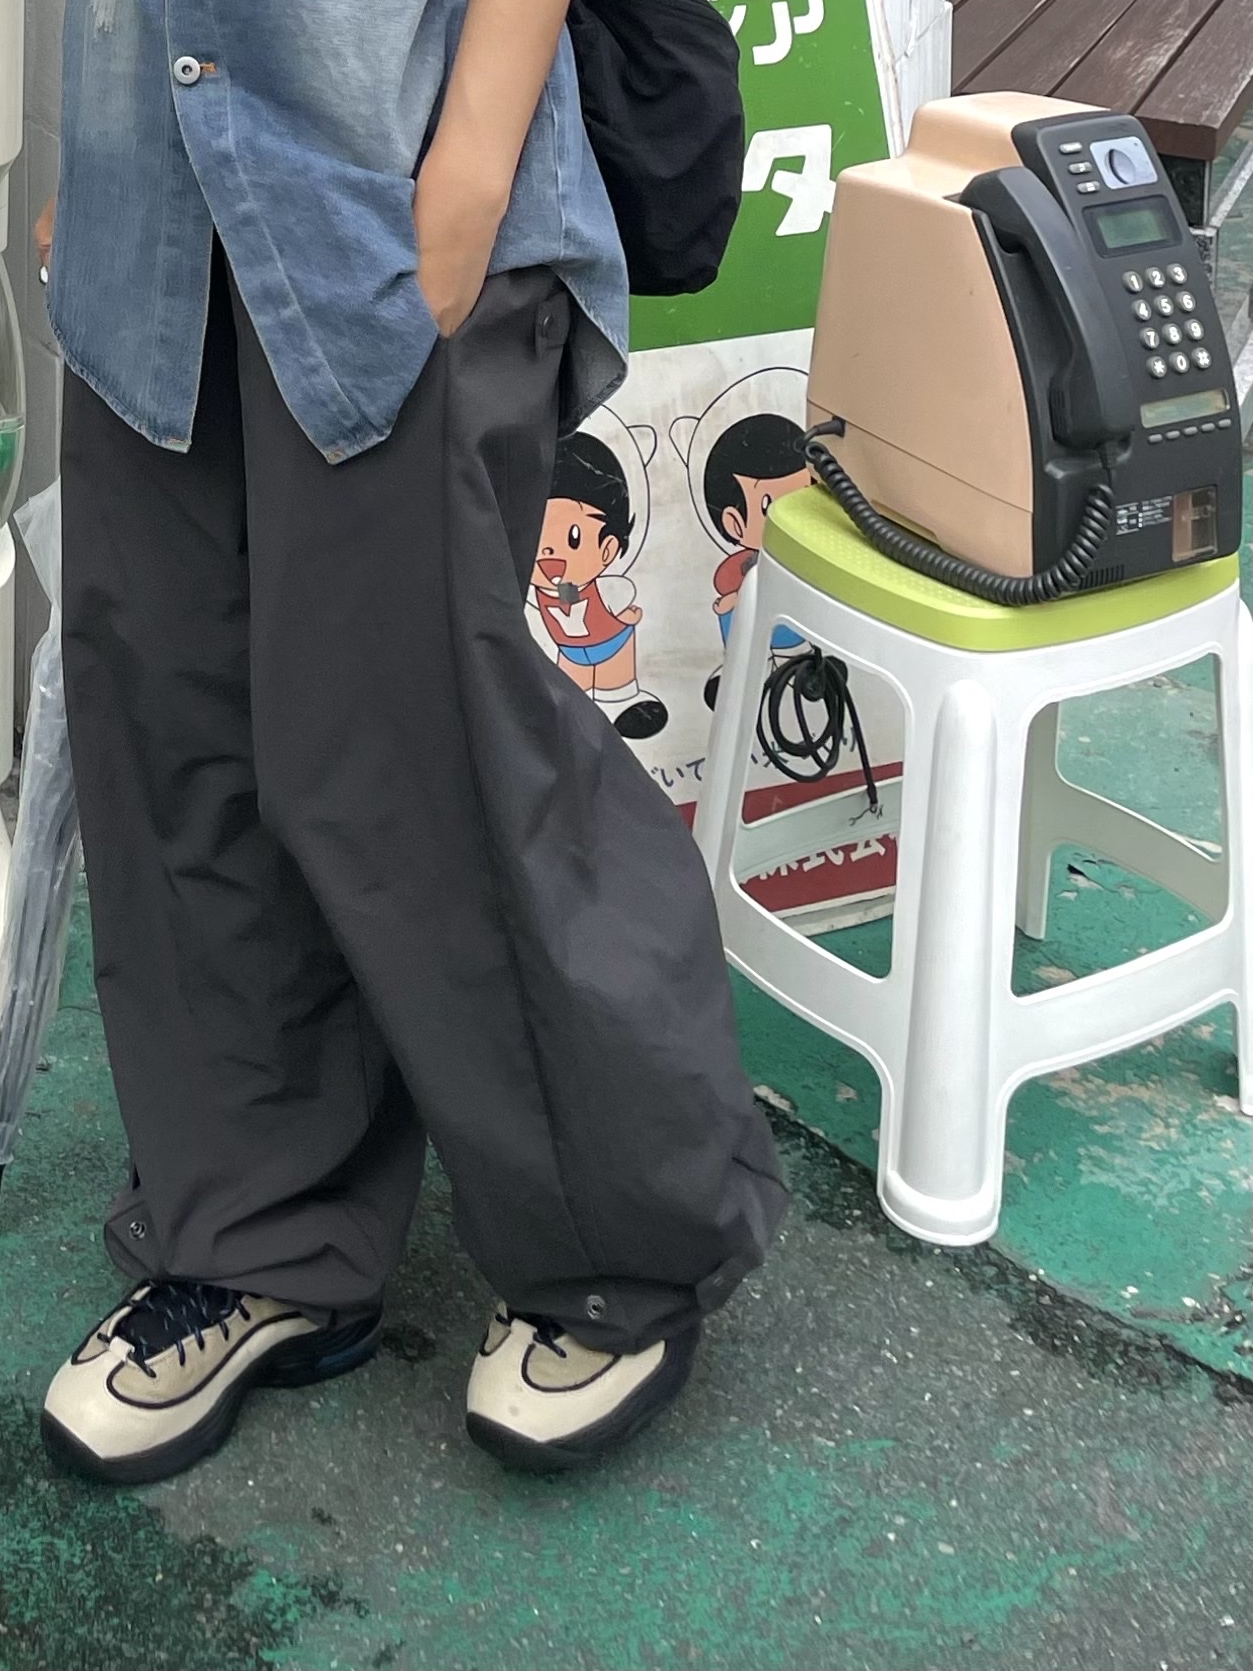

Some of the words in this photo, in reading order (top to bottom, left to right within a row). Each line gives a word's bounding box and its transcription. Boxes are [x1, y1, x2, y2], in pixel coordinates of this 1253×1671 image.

[1152, 271, 1164, 286] 2
[1173, 267, 1185, 281] 3
[1139, 302, 1149, 317] 4
[1160, 298, 1171, 313] 5
[1182, 294, 1193, 309] 6
[1146, 331, 1155, 347] 7
[1169, 326, 1180, 341] 8
[1190, 322, 1201, 337] 9
[1176, 355, 1187, 368] 0
